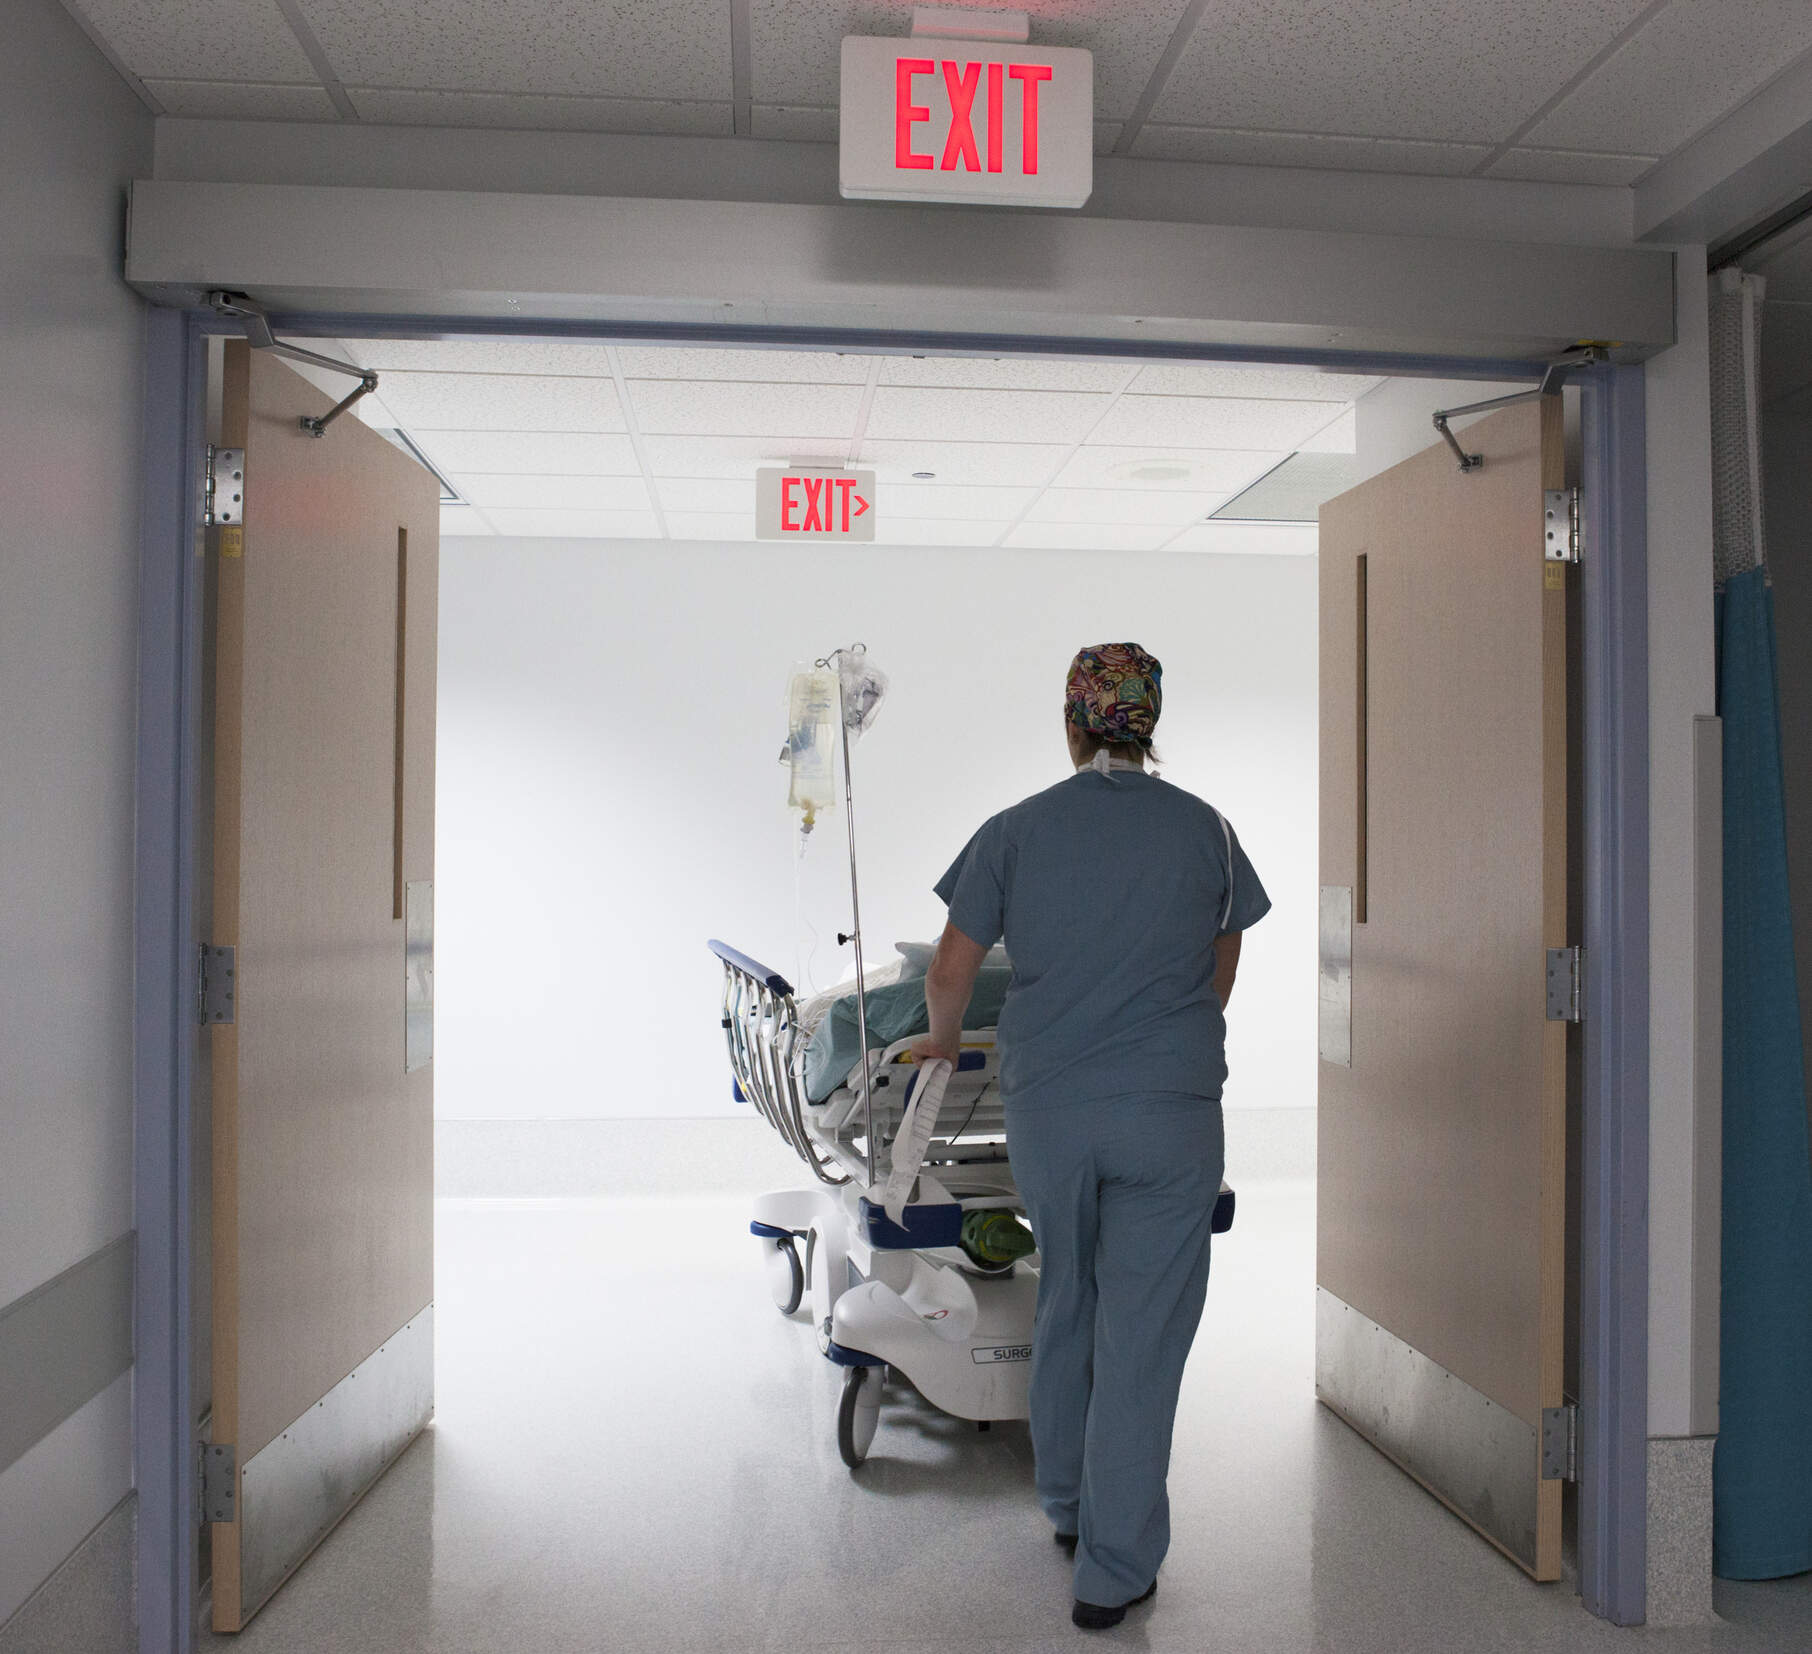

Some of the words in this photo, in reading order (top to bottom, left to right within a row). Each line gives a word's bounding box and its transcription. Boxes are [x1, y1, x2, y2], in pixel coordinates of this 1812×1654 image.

[895, 57, 1053, 175] EXIT
[781, 477, 857, 532] EXIT
[993, 1347, 1032, 1361] SURG
